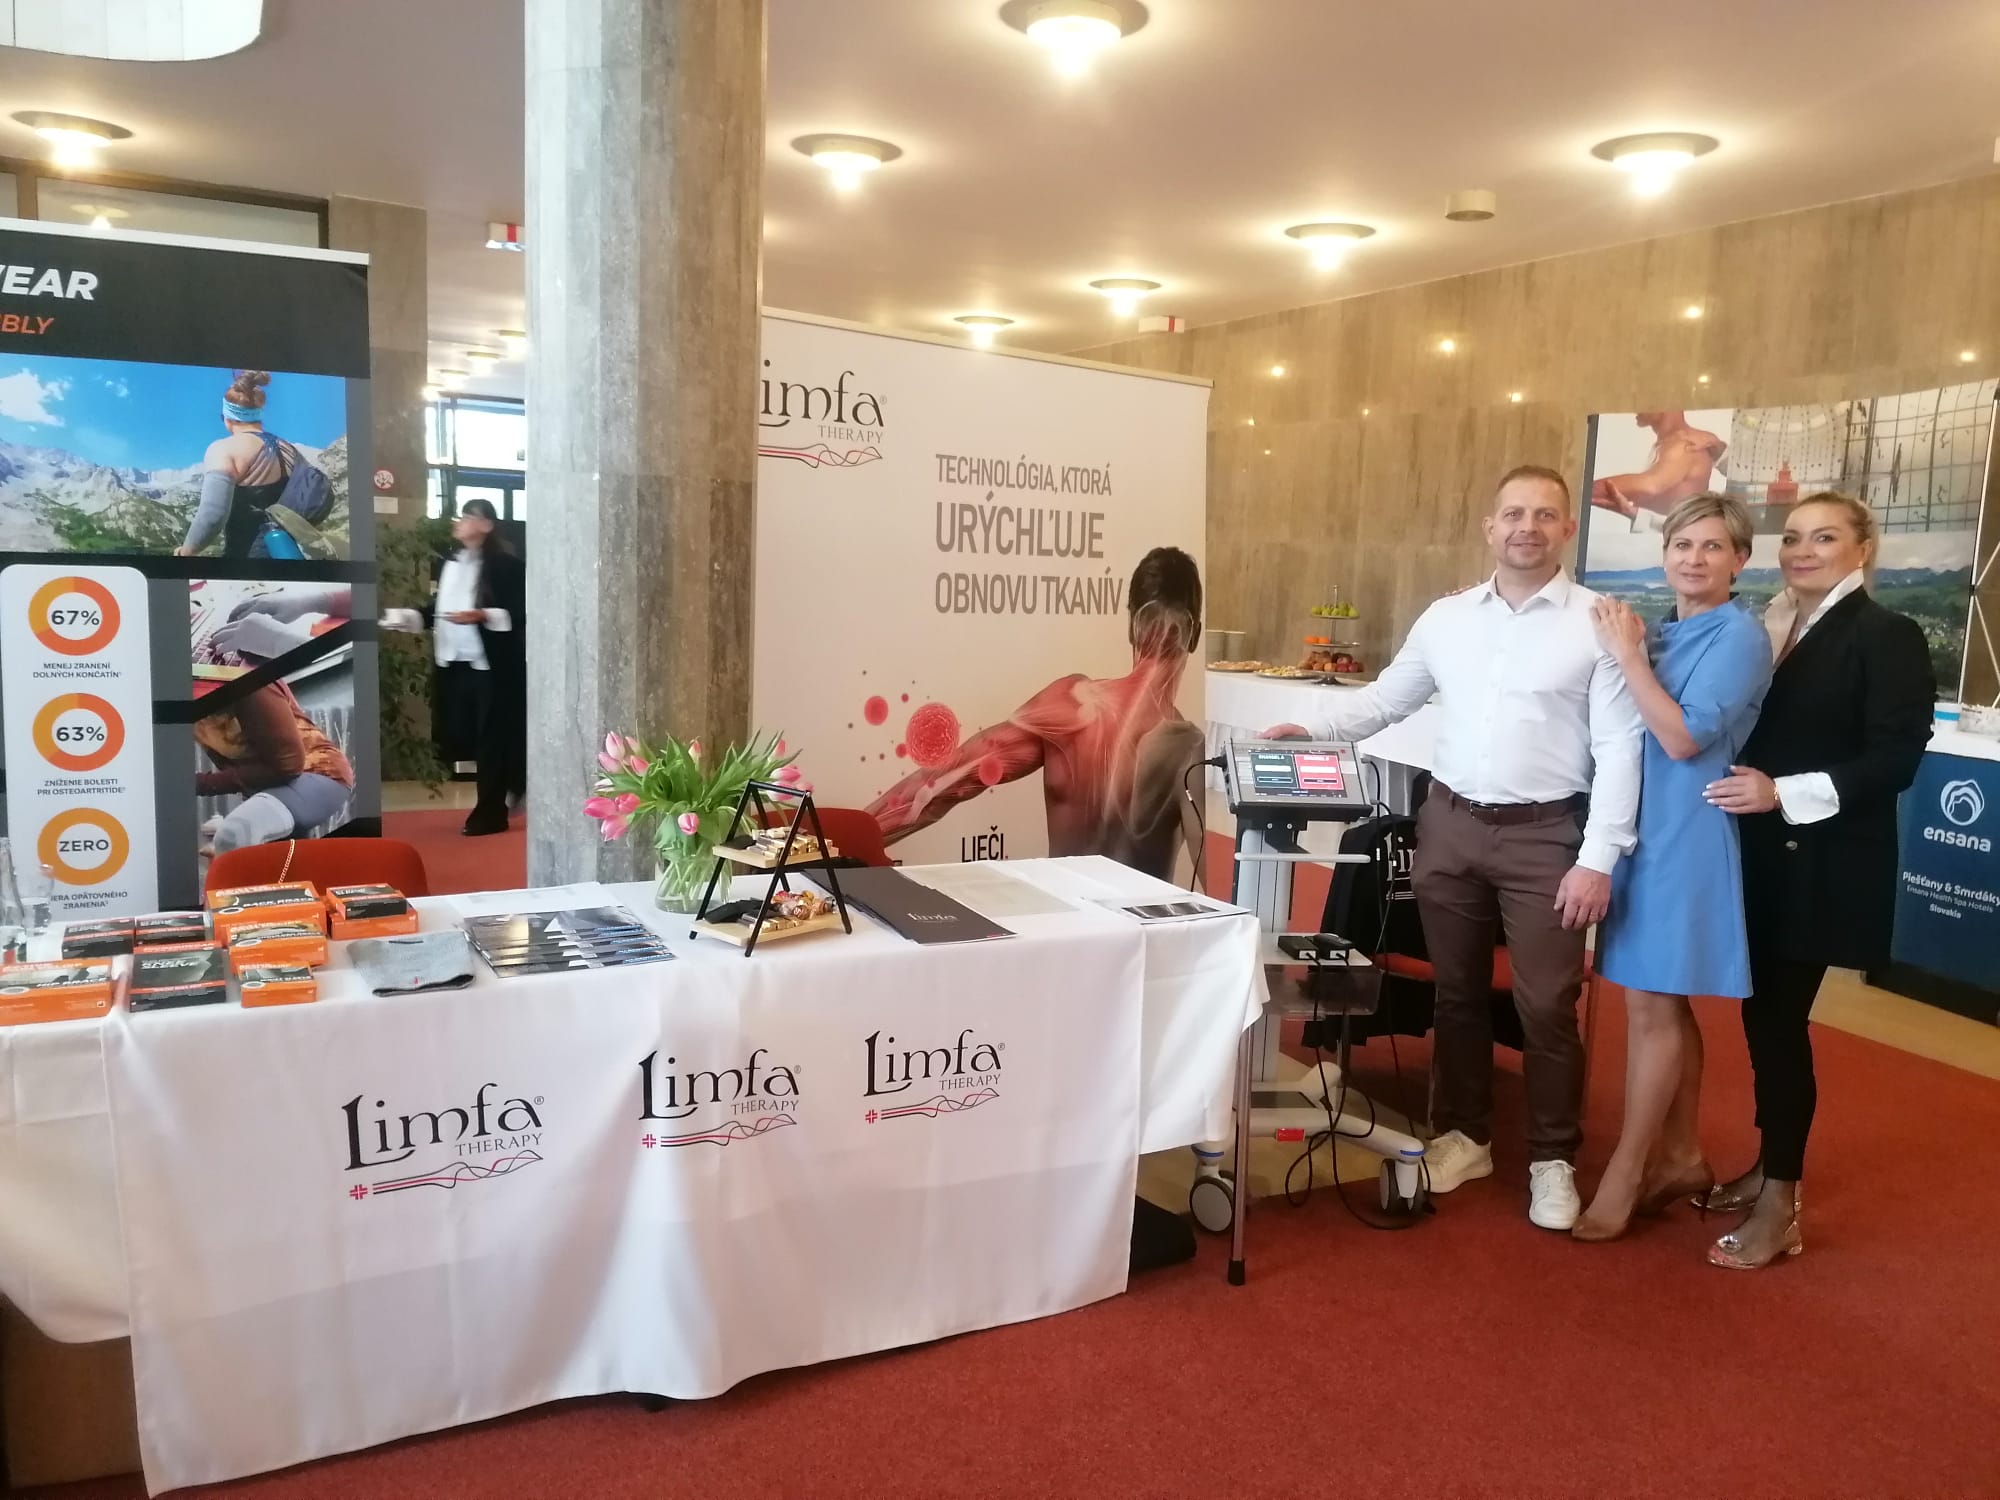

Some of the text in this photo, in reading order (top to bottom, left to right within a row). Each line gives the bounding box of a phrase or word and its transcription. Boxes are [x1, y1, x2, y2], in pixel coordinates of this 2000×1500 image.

[0, 264, 98, 300] EAR
[0, 314, 54, 334] BLY
[817, 424, 883, 444] THERAPY
[936, 454, 1112, 496] TECHNOLÓGIA, KTORÁ
[936, 490, 1104, 559] URÝCHĽUJE
[936, 566, 1123, 615] OBNOVU TKANÍV
[51, 610, 99, 625] 67%
[33, 670, 74, 678] DOLNÝCH
[74, 661, 110, 669] ZRANENÍ
[56, 726, 105, 741] 63%
[84, 778, 118, 786] BOLESTI
[59, 839, 109, 852] ZERO
[1923, 826, 1991, 853] ensana
[1944, 882, 1953, 893] &
[1953, 884, 2000, 906] Smrdáky
[1929, 903, 1961, 919] Slovakia
[1968, 901, 1994, 914] Hotels
[938, 1073, 1001, 1091] THERAPY
[731, 1099, 799, 1116] THERAPY
[454, 1132, 544, 1157] THERAPY
